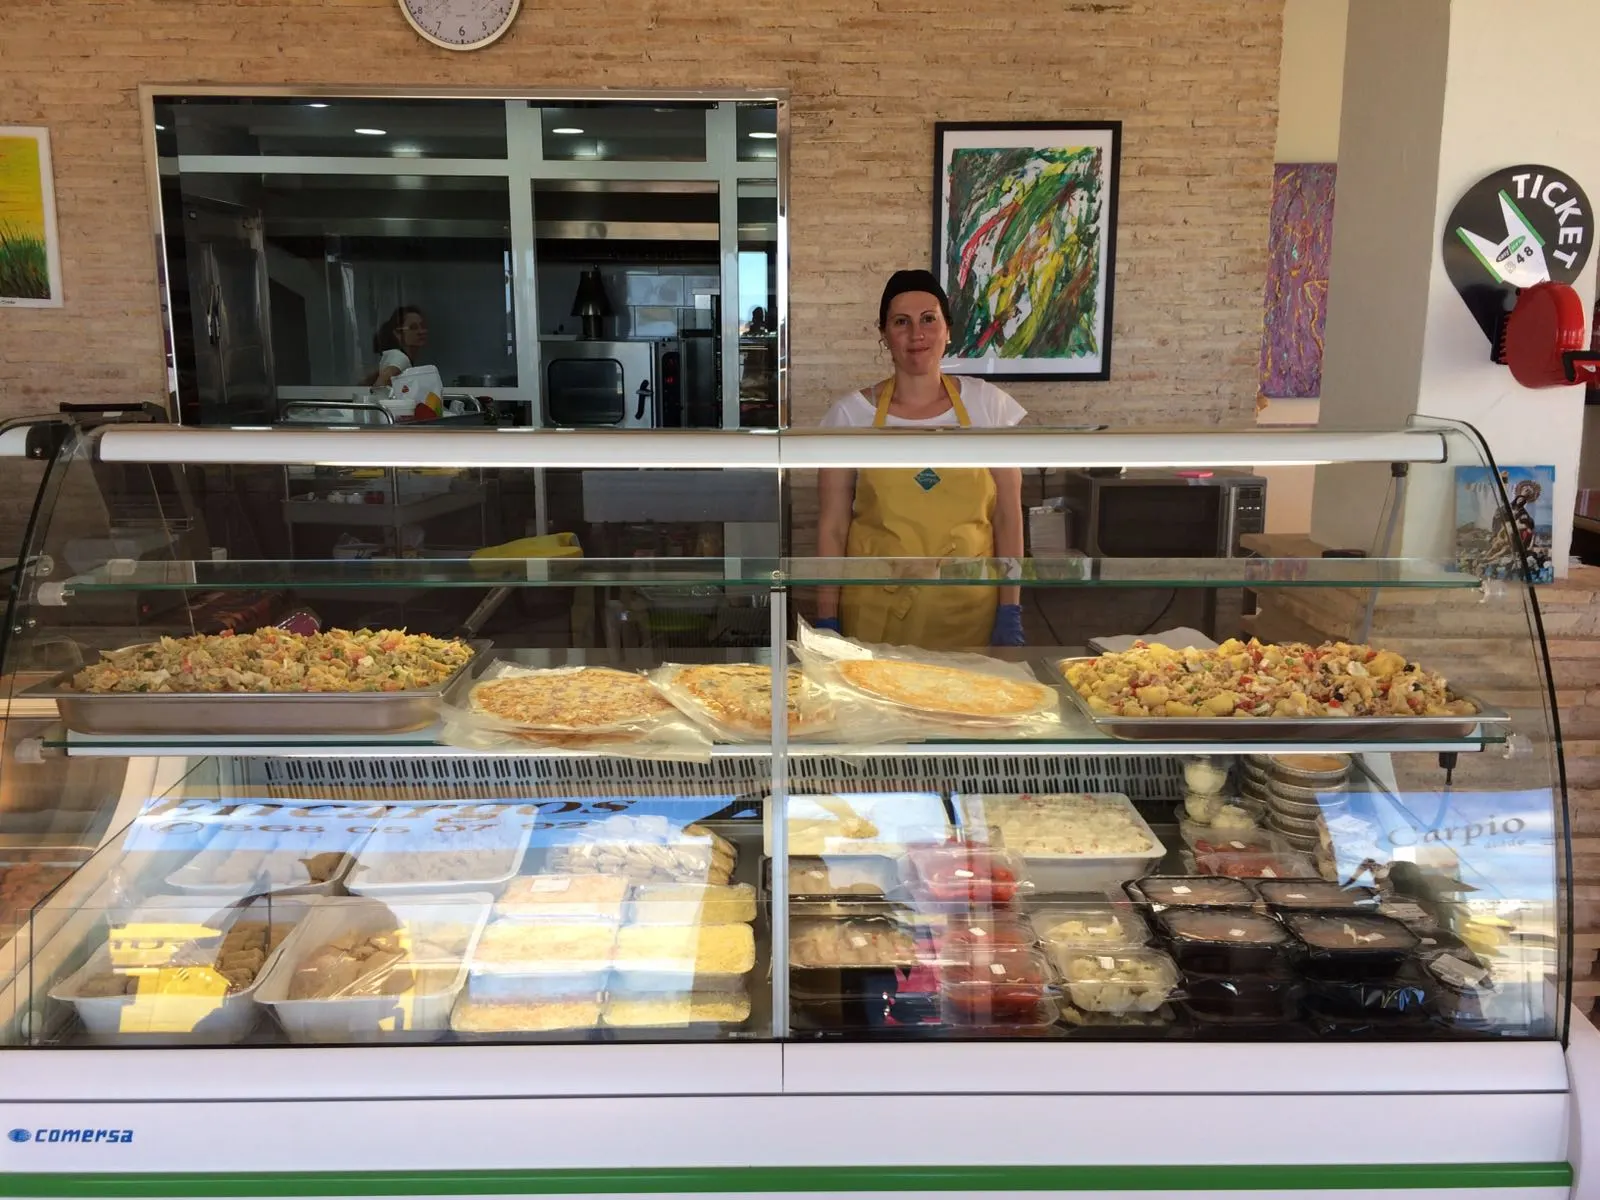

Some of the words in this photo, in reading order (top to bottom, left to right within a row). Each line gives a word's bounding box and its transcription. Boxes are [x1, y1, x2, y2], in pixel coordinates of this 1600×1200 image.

[436, 21, 442, 31] 7
[458, 25, 466, 36] 6
[1512, 173, 1583, 270] TICKET
[1387, 814, 1526, 847] Carpio
[34, 1128, 134, 1143] comersa
